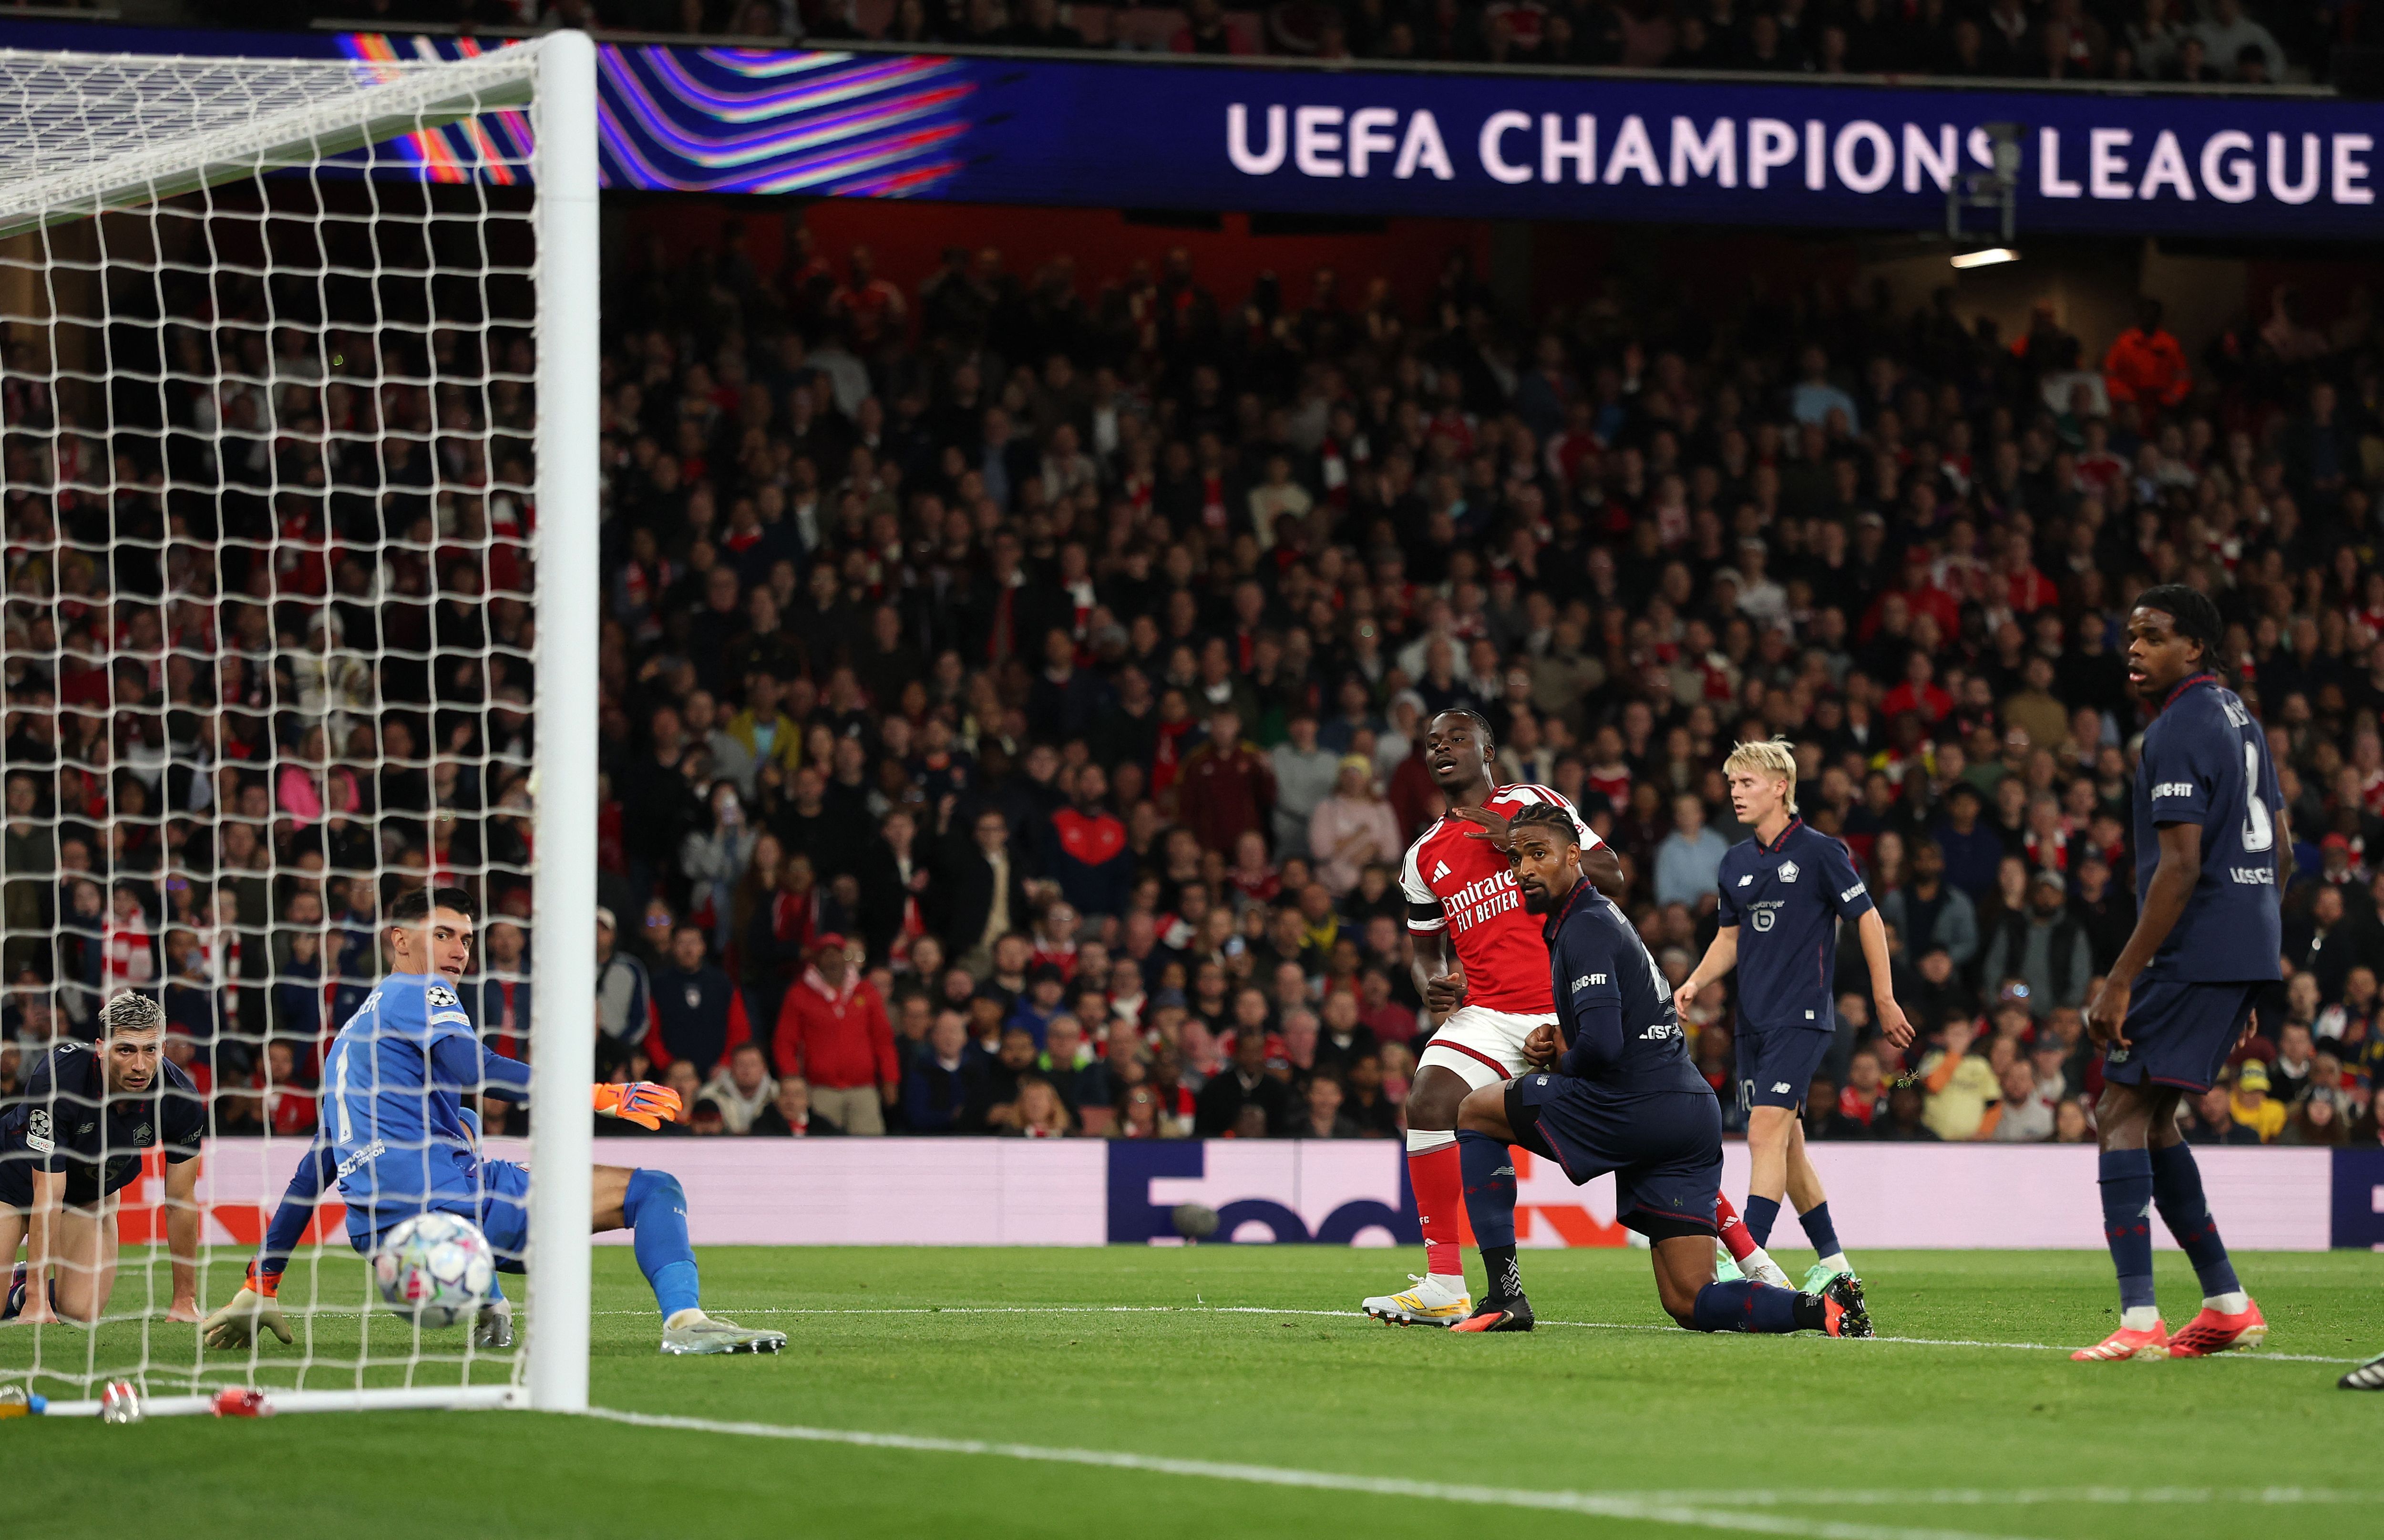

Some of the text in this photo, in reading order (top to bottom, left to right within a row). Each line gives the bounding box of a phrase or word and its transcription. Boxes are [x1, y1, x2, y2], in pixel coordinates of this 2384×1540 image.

[1227, 104, 1453, 180] UEFA
[2040, 128, 2374, 204] LEAGUE
[1441, 869, 1518, 918] Emirate
[1456, 890, 1519, 933] FLY BETTER
